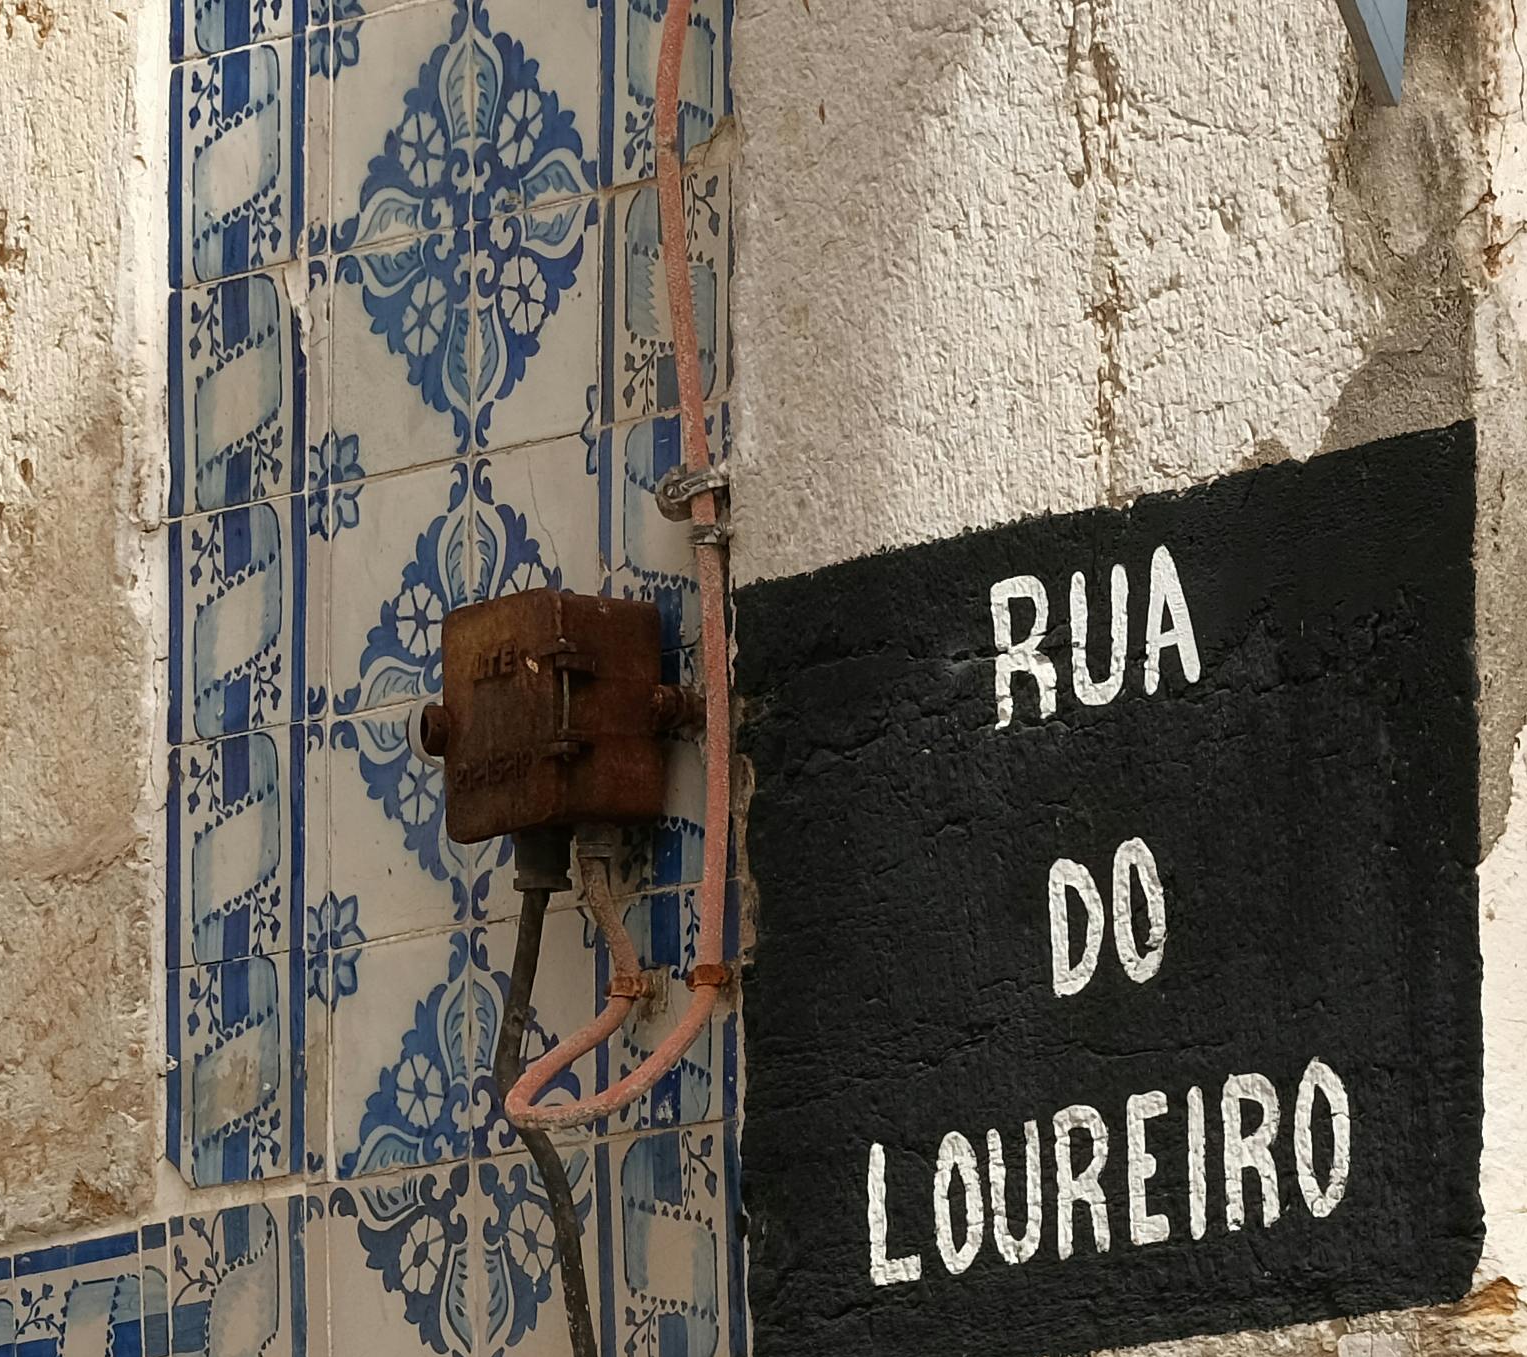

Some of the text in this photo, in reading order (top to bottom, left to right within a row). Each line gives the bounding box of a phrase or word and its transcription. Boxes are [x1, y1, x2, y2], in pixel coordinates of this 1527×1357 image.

[988, 542, 1202, 731] RUA
[1047, 836, 1169, 999] DO
[866, 1055, 1352, 1287] LOUREIRO
